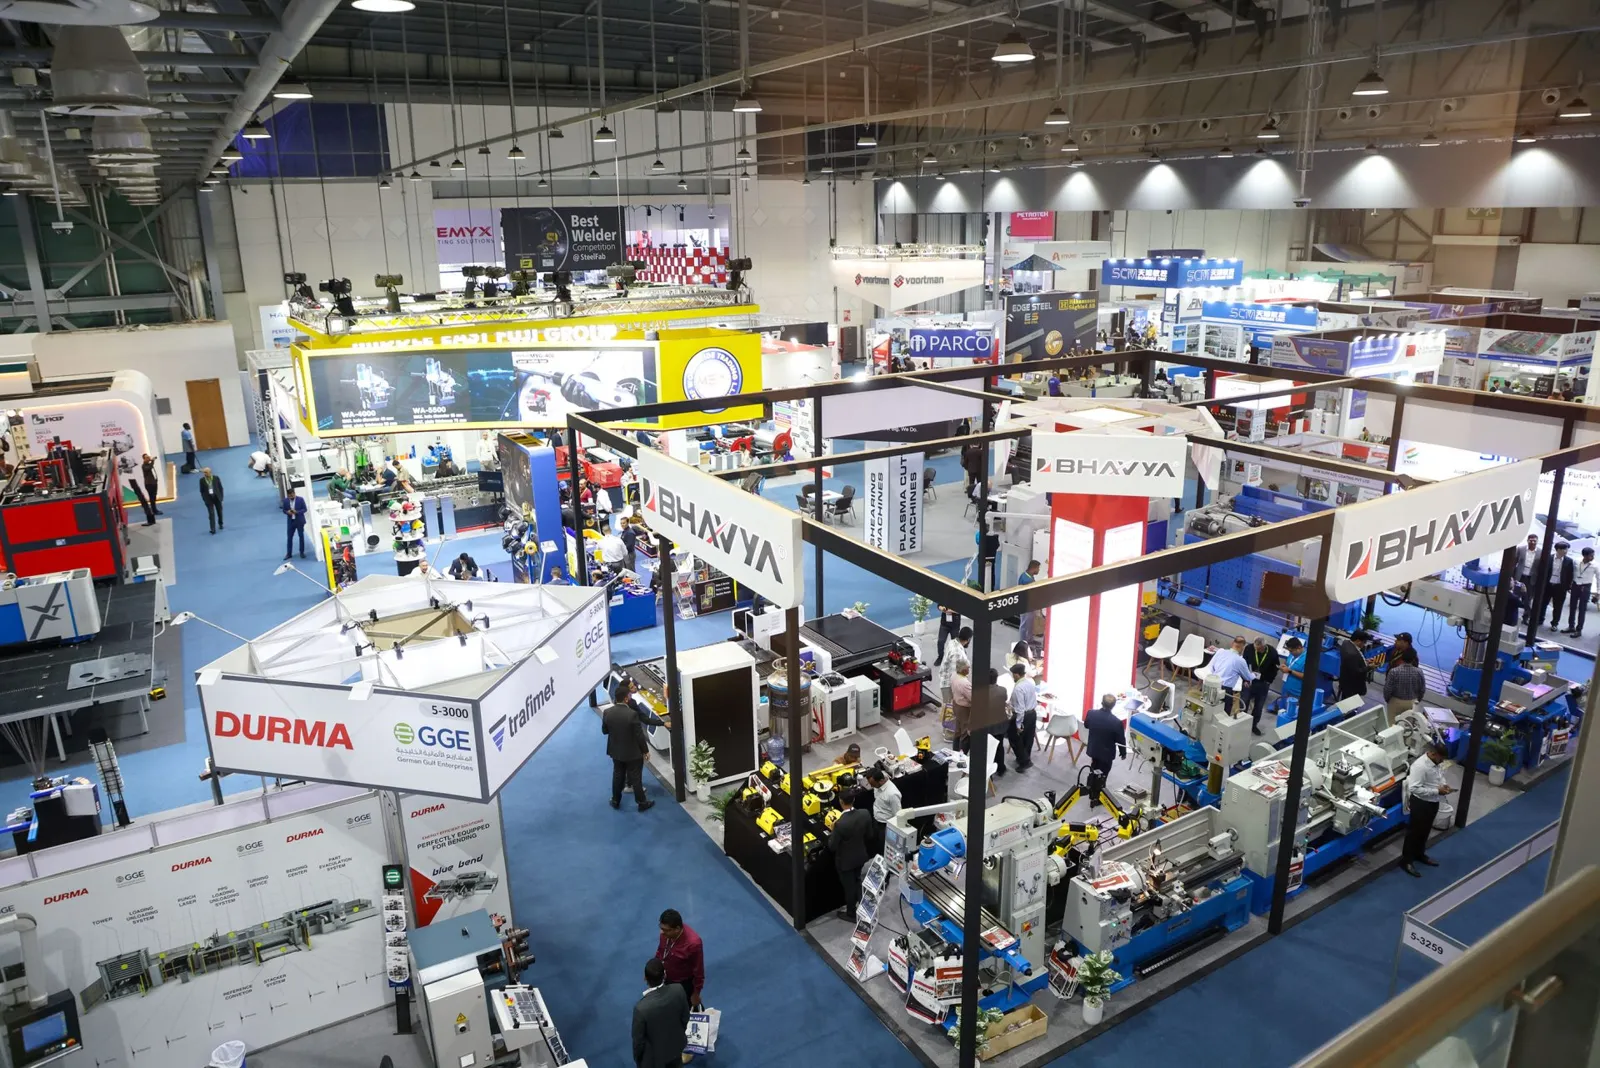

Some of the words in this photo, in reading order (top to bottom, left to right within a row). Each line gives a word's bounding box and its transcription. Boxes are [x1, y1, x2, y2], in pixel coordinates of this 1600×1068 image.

[571, 215, 599, 227] Best
[456, 237, 495, 245] SOLUTIONS
[572, 229, 616, 242] Welder
[572, 243, 616, 252] Competition
[906, 276, 944, 284] voortman
[1112, 268, 1138, 280] SCM
[1186, 269, 1210, 282] SCM
[862, 276, 890, 285] voortman
[1012, 304, 1030, 312] EDGE
[1032, 302, 1052, 311] STEEL
[1229, 308, 1256, 320] SCM
[543, 324, 617, 342] GROUP
[930, 335, 990, 352] PARCO
[1056, 458, 1176, 478] BHAVYA
[1568, 472, 1596, 480] Future
[658, 486, 782, 584] BHAVYA
[1374, 494, 1524, 572] BHAVYA
[988, 595, 1019, 610] 5-3005
[589, 600, 604, 619] 5-3000
[584, 620, 604, 650] GGE
[432, 706, 468, 718] 5-3000
[508, 676, 556, 738] trafimet
[214, 710, 354, 750] DURMA
[418, 726, 472, 751] GGE
[397, 756, 422, 765] German
[438, 760, 474, 771] Enterprises
[411, 803, 446, 818] DURMA
[354, 812, 371, 822] GGE
[286, 828, 324, 843] DURMA
[417, 834, 456, 850] PERFECTLY
[457, 823, 490, 837] EQUIPPED
[432, 842, 446, 851] FOR
[448, 832, 477, 846] BENDING
[245, 840, 264, 850] GGE
[172, 856, 212, 872] DURMA
[286, 864, 308, 874] BENDING
[327, 864, 346, 872] SYSTEM
[432, 864, 454, 876] blue
[458, 854, 484, 868] bend
[124, 870, 145, 881] GGE
[288, 870, 308, 878] CENTER
[250, 880, 268, 888] DEVICE
[44, 888, 89, 906] DURMA
[178, 894, 196, 902] PUNCH
[214, 898, 236, 907] SYSTEM
[0, 904, 16, 914] GE
[178, 900, 196, 908] LASER
[126, 910, 159, 922] UNLOADING
[129, 906, 154, 916] LOADING
[92, 917, 113, 926] TOWER
[132, 916, 155, 925] SYSTEM
[1410, 932, 1444, 955] 5-3259
[264, 974, 287, 984] STACKER
[266, 978, 286, 988] SYSTEM
[222, 984, 254, 997] REFERENCE
[224, 989, 254, 1001] CONVEYOR
